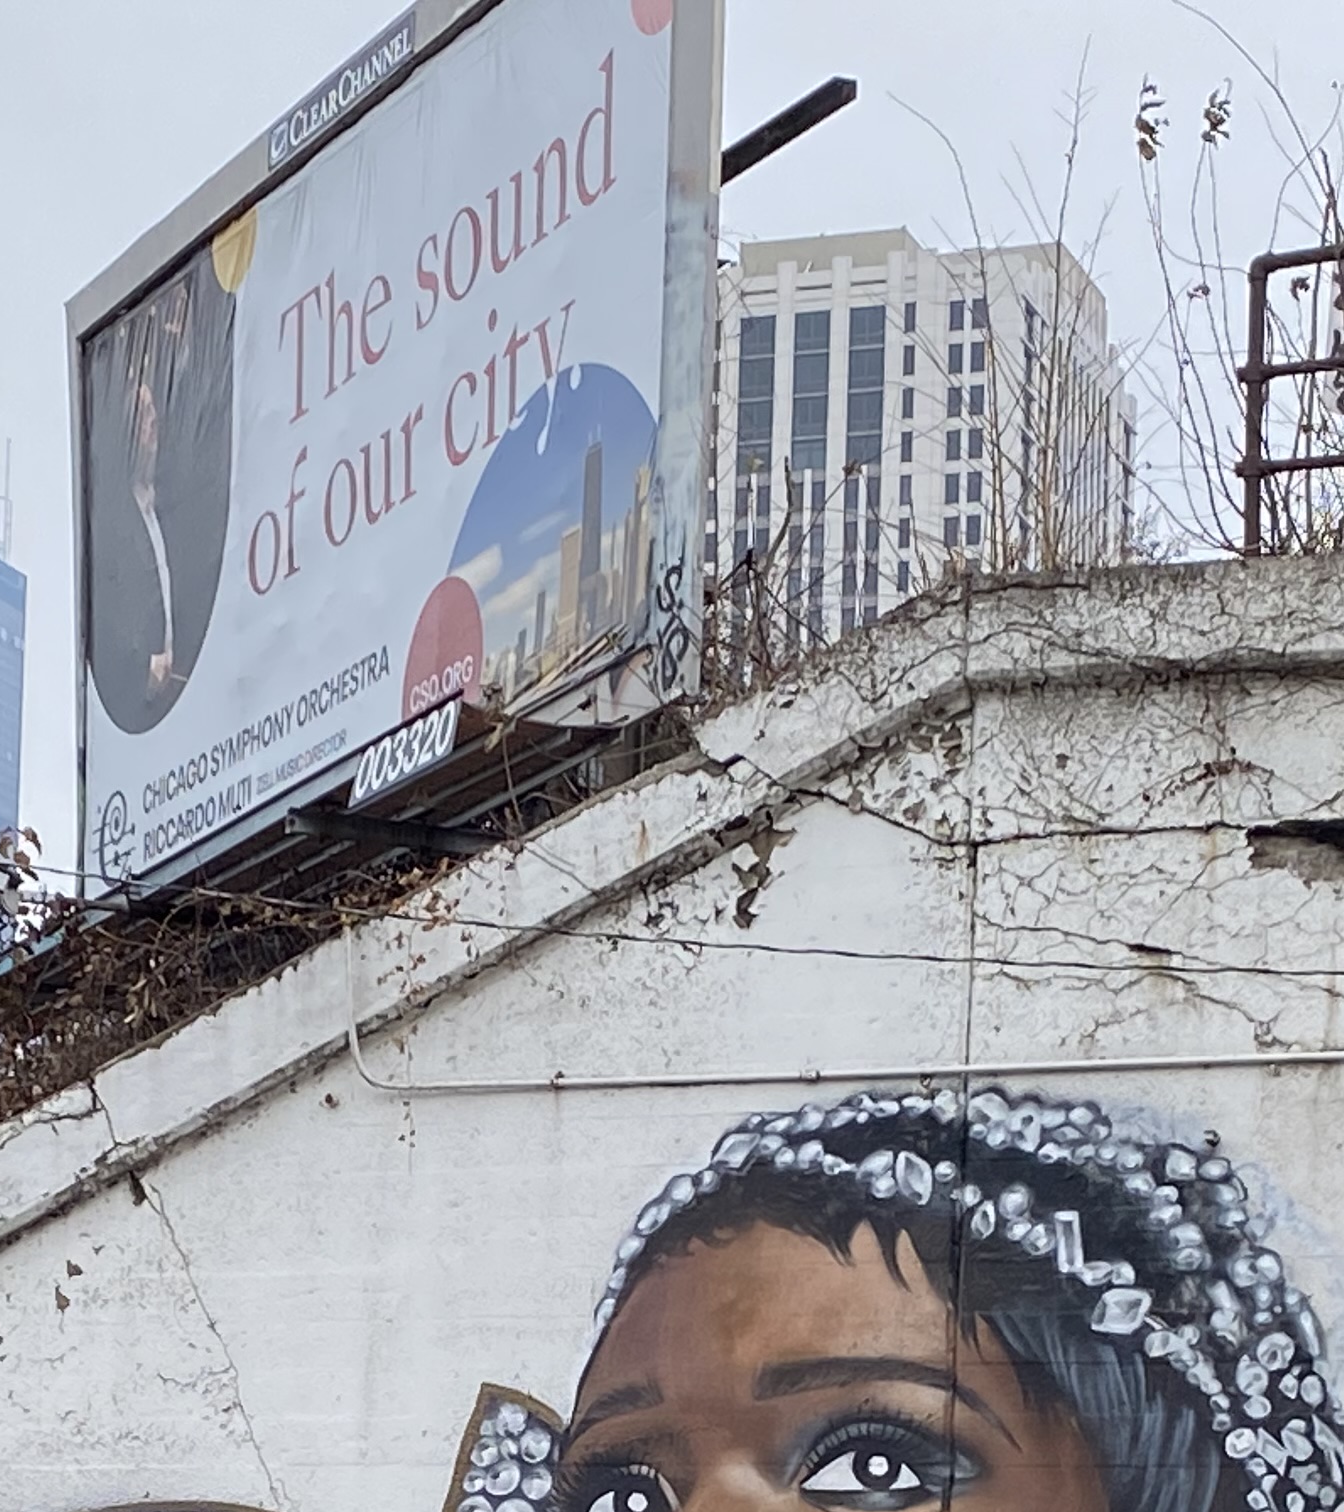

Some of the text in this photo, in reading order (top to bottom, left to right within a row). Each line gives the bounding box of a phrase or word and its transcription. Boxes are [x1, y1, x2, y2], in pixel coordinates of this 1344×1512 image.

[277, 47, 618, 425] The sound
[248, 445, 308, 597] of
[323, 403, 425, 548] our
[143, 645, 390, 814] CHICAGO SYMPHONY ORCHESTRA
[354, 700, 455, 800] 003320
[410, 655, 473, 713] CSO.ORG
[143, 774, 252, 863] RICCARDO MUTI
